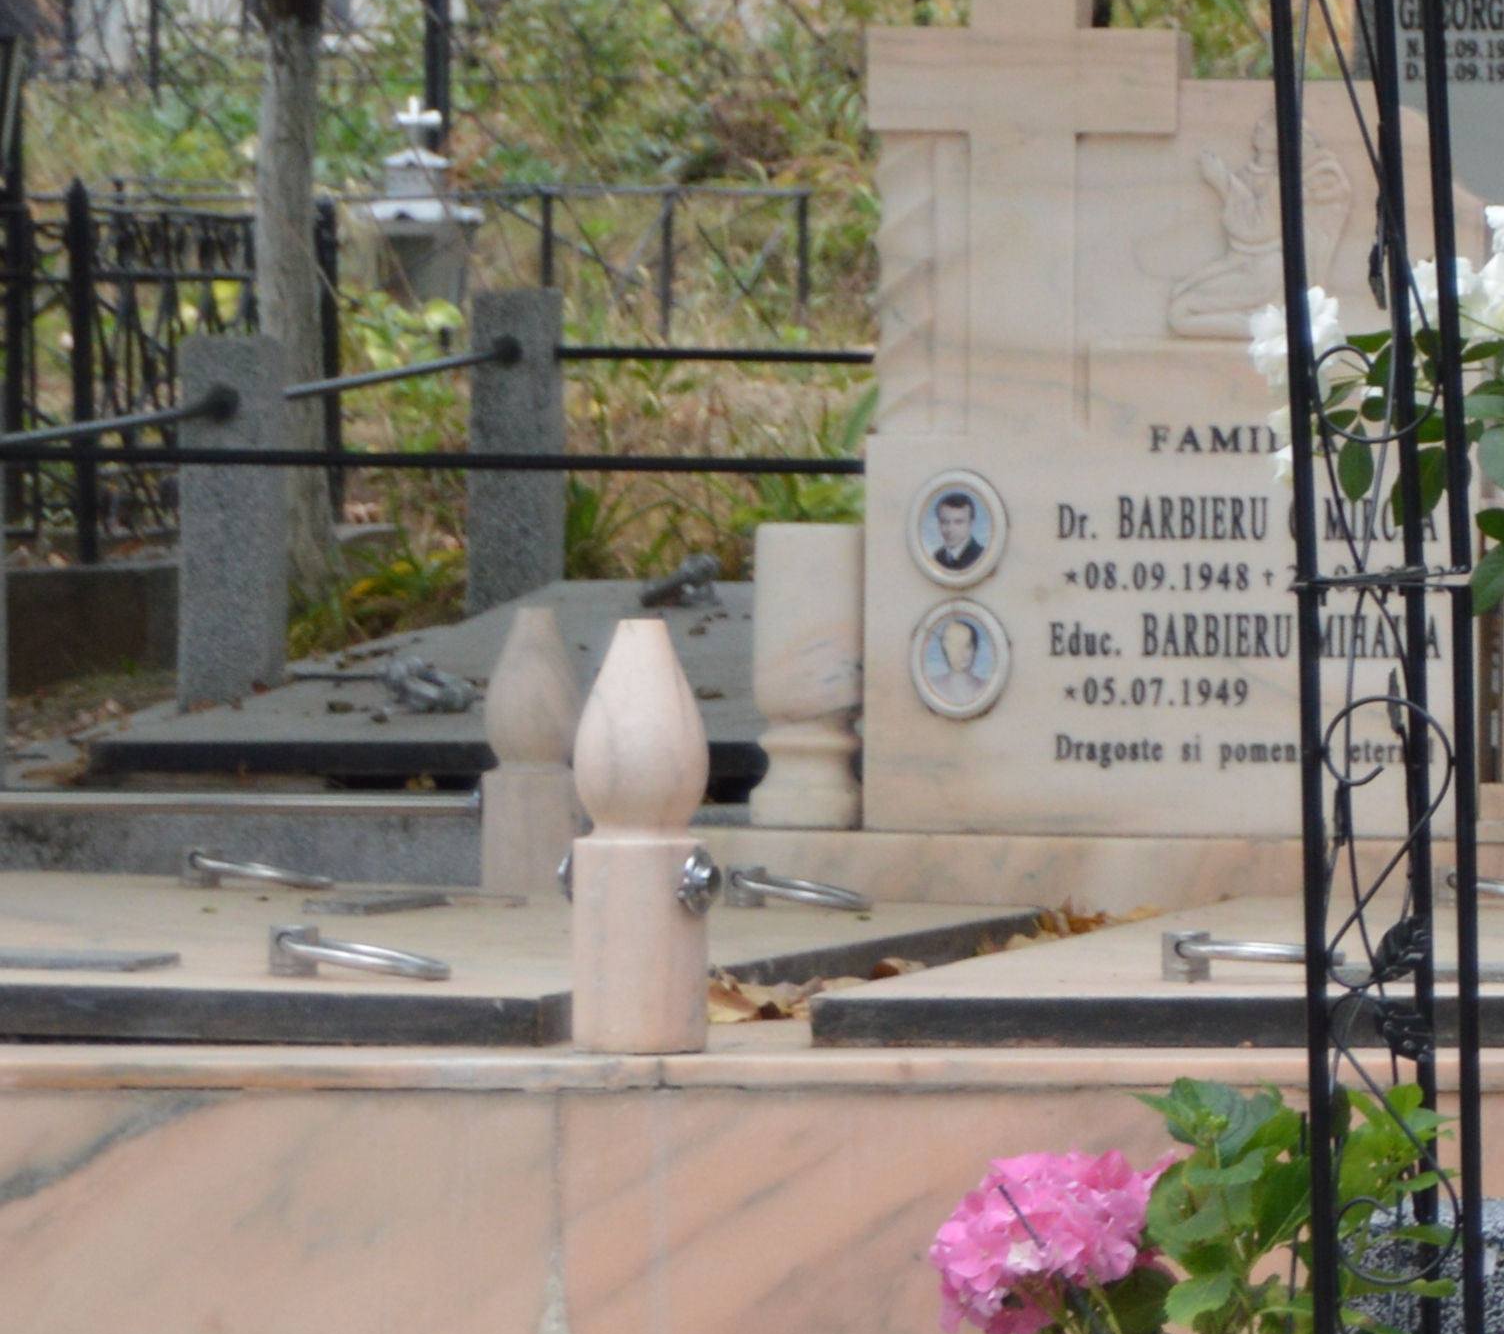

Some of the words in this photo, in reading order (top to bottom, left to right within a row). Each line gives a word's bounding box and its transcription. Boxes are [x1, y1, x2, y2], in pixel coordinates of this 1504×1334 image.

[1057, 503, 1097, 539] Dr.
[1118, 495, 1269, 541] BARBIERU
[1050, 621, 1122, 658] Educ.
[1141, 612, 1293, 659] BARBIERU
[1054, 733, 1164, 769] Dragoste
[1181, 734, 1202, 763] si
